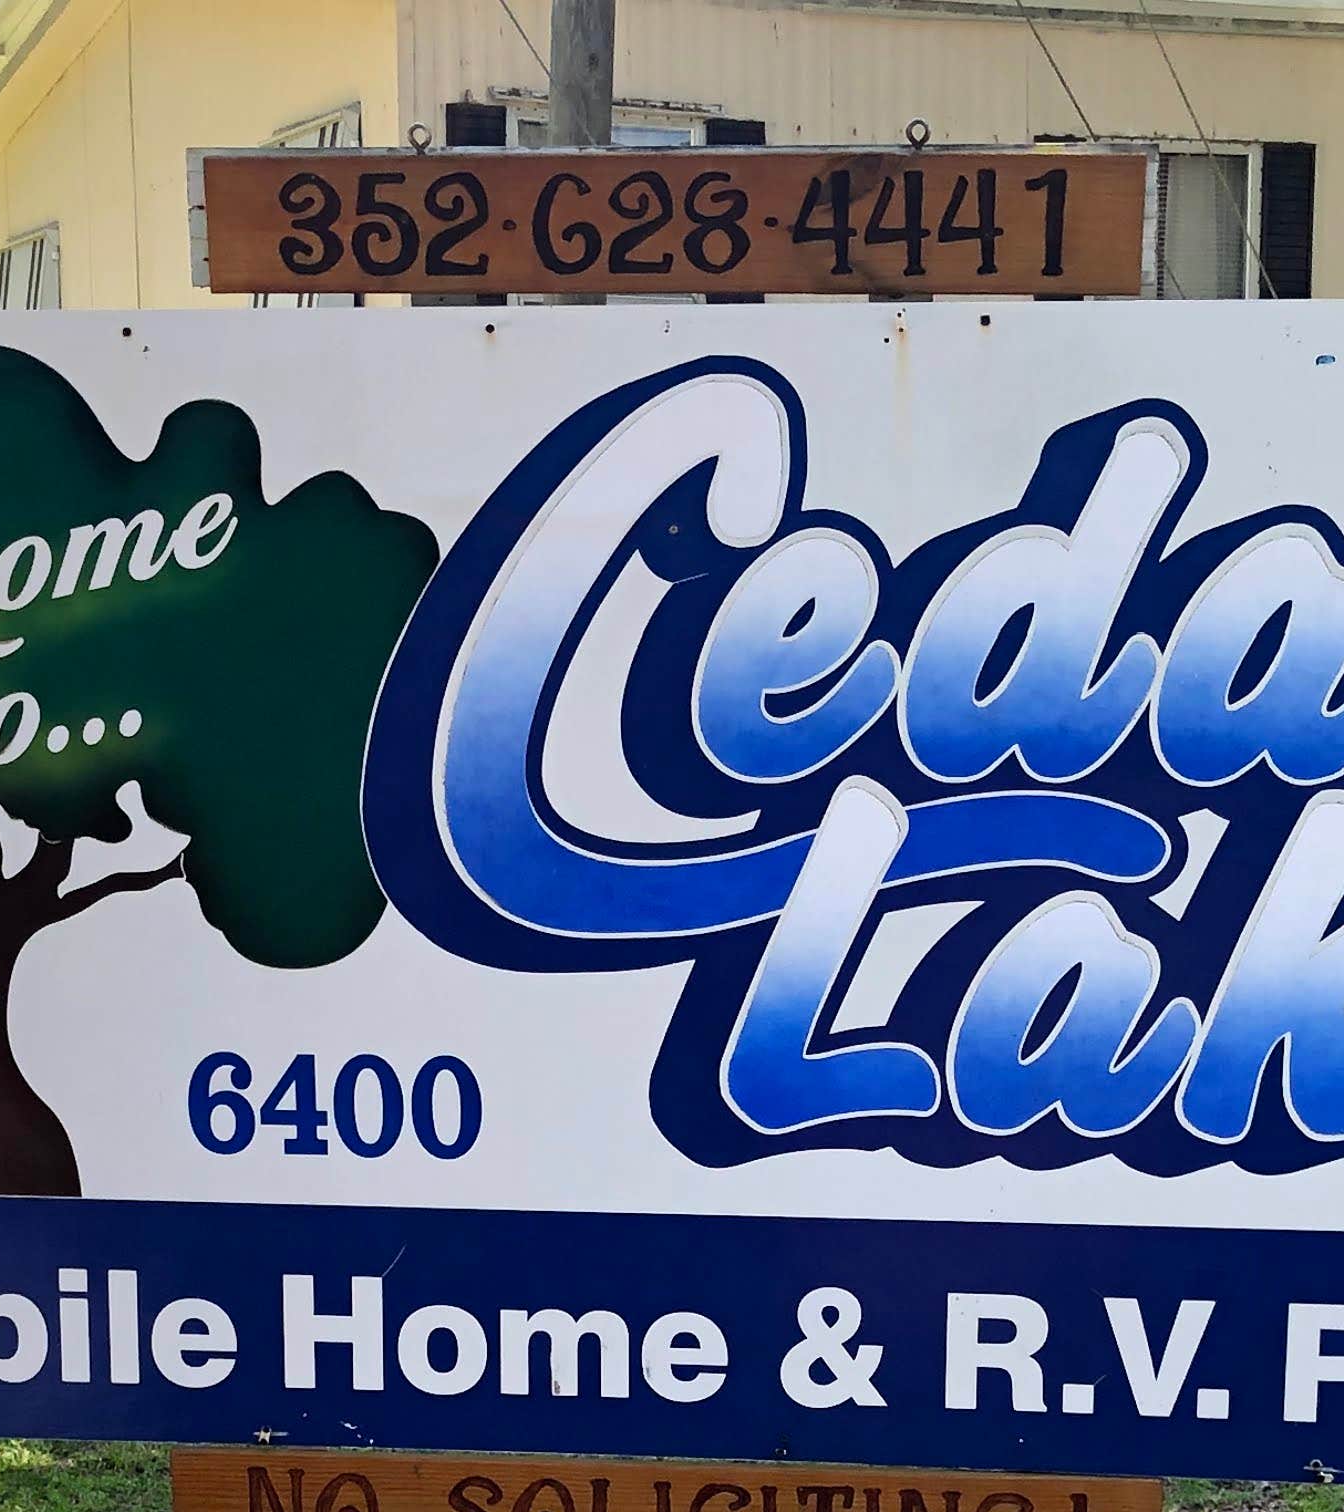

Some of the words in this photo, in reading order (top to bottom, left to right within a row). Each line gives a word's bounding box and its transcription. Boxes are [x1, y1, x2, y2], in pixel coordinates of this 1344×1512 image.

[187, 1051, 484, 1160] 6400
[282, 1273, 729, 1402] Home
[780, 1286, 887, 1409] &
[944, 1292, 1230, 1420] R.V.
